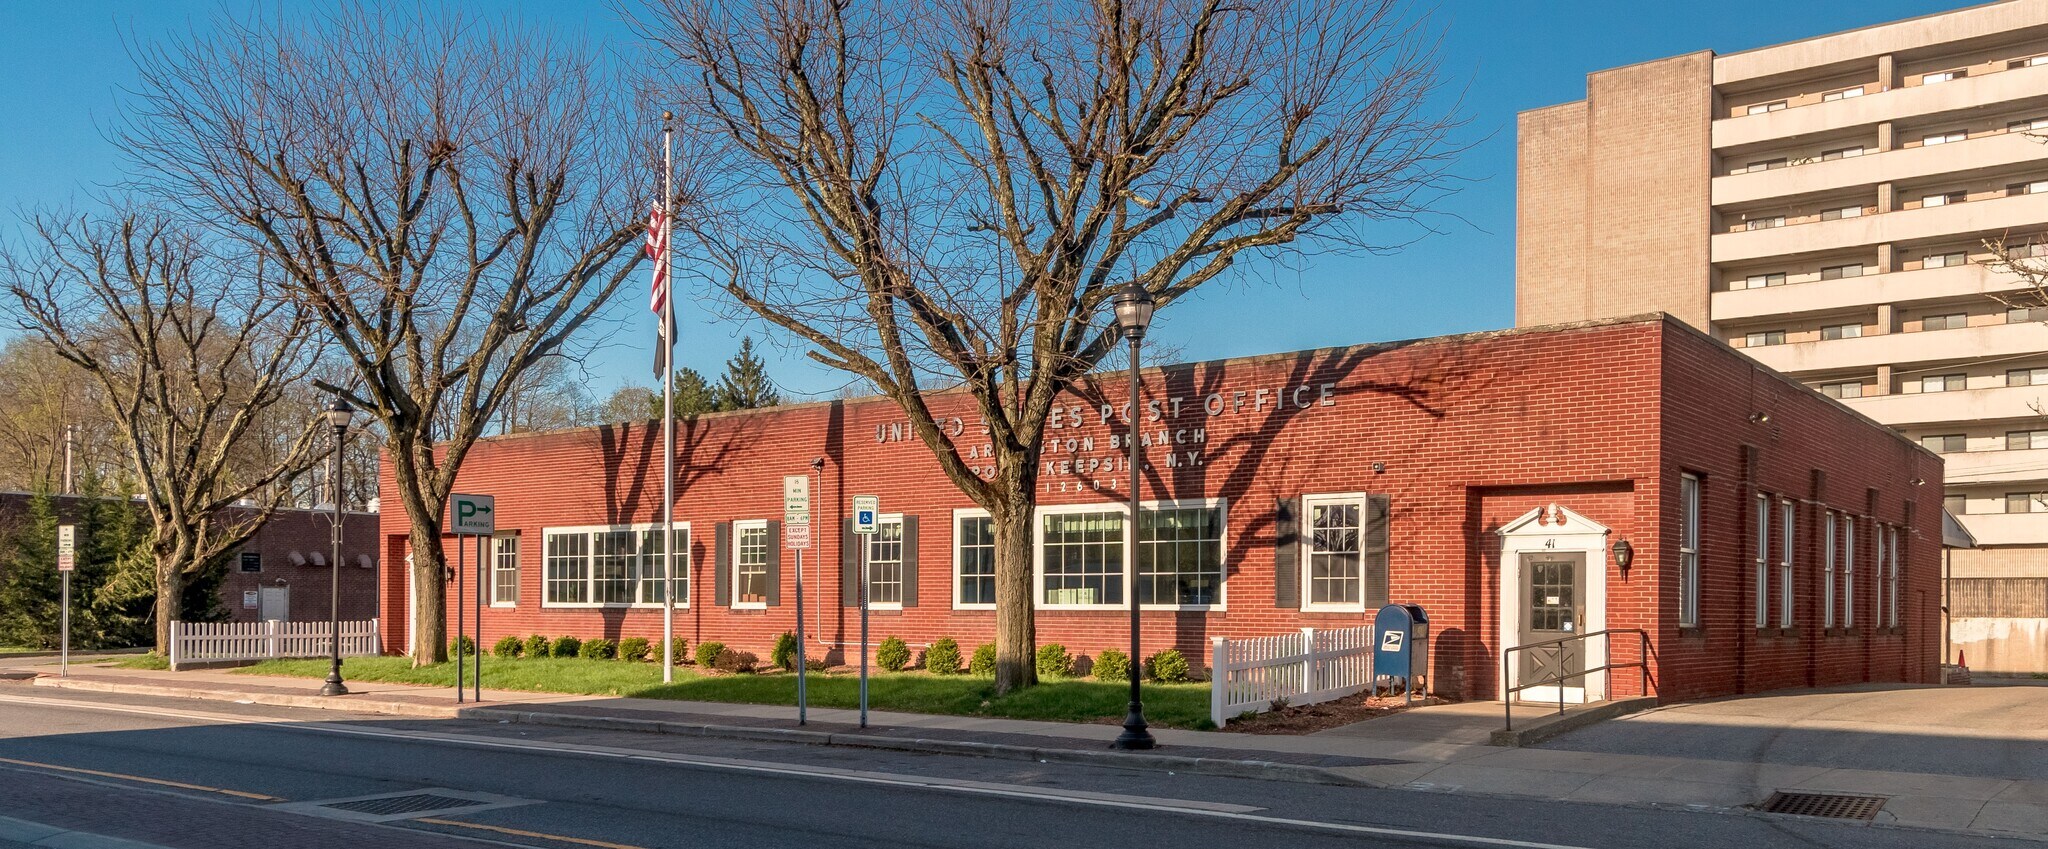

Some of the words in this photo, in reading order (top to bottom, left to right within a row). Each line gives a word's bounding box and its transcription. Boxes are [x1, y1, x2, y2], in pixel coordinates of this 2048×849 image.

[876, 417, 963, 443] UNIED
[981, 406, 1082, 435] SES
[1204, 383, 1335, 415] OFFICE
[970, 437, 1093, 459] ARTON
[1166, 451, 1203, 467] N.Y.
[1046, 479, 1116, 492] 12603
[1545, 539, 1555, 549] 41
